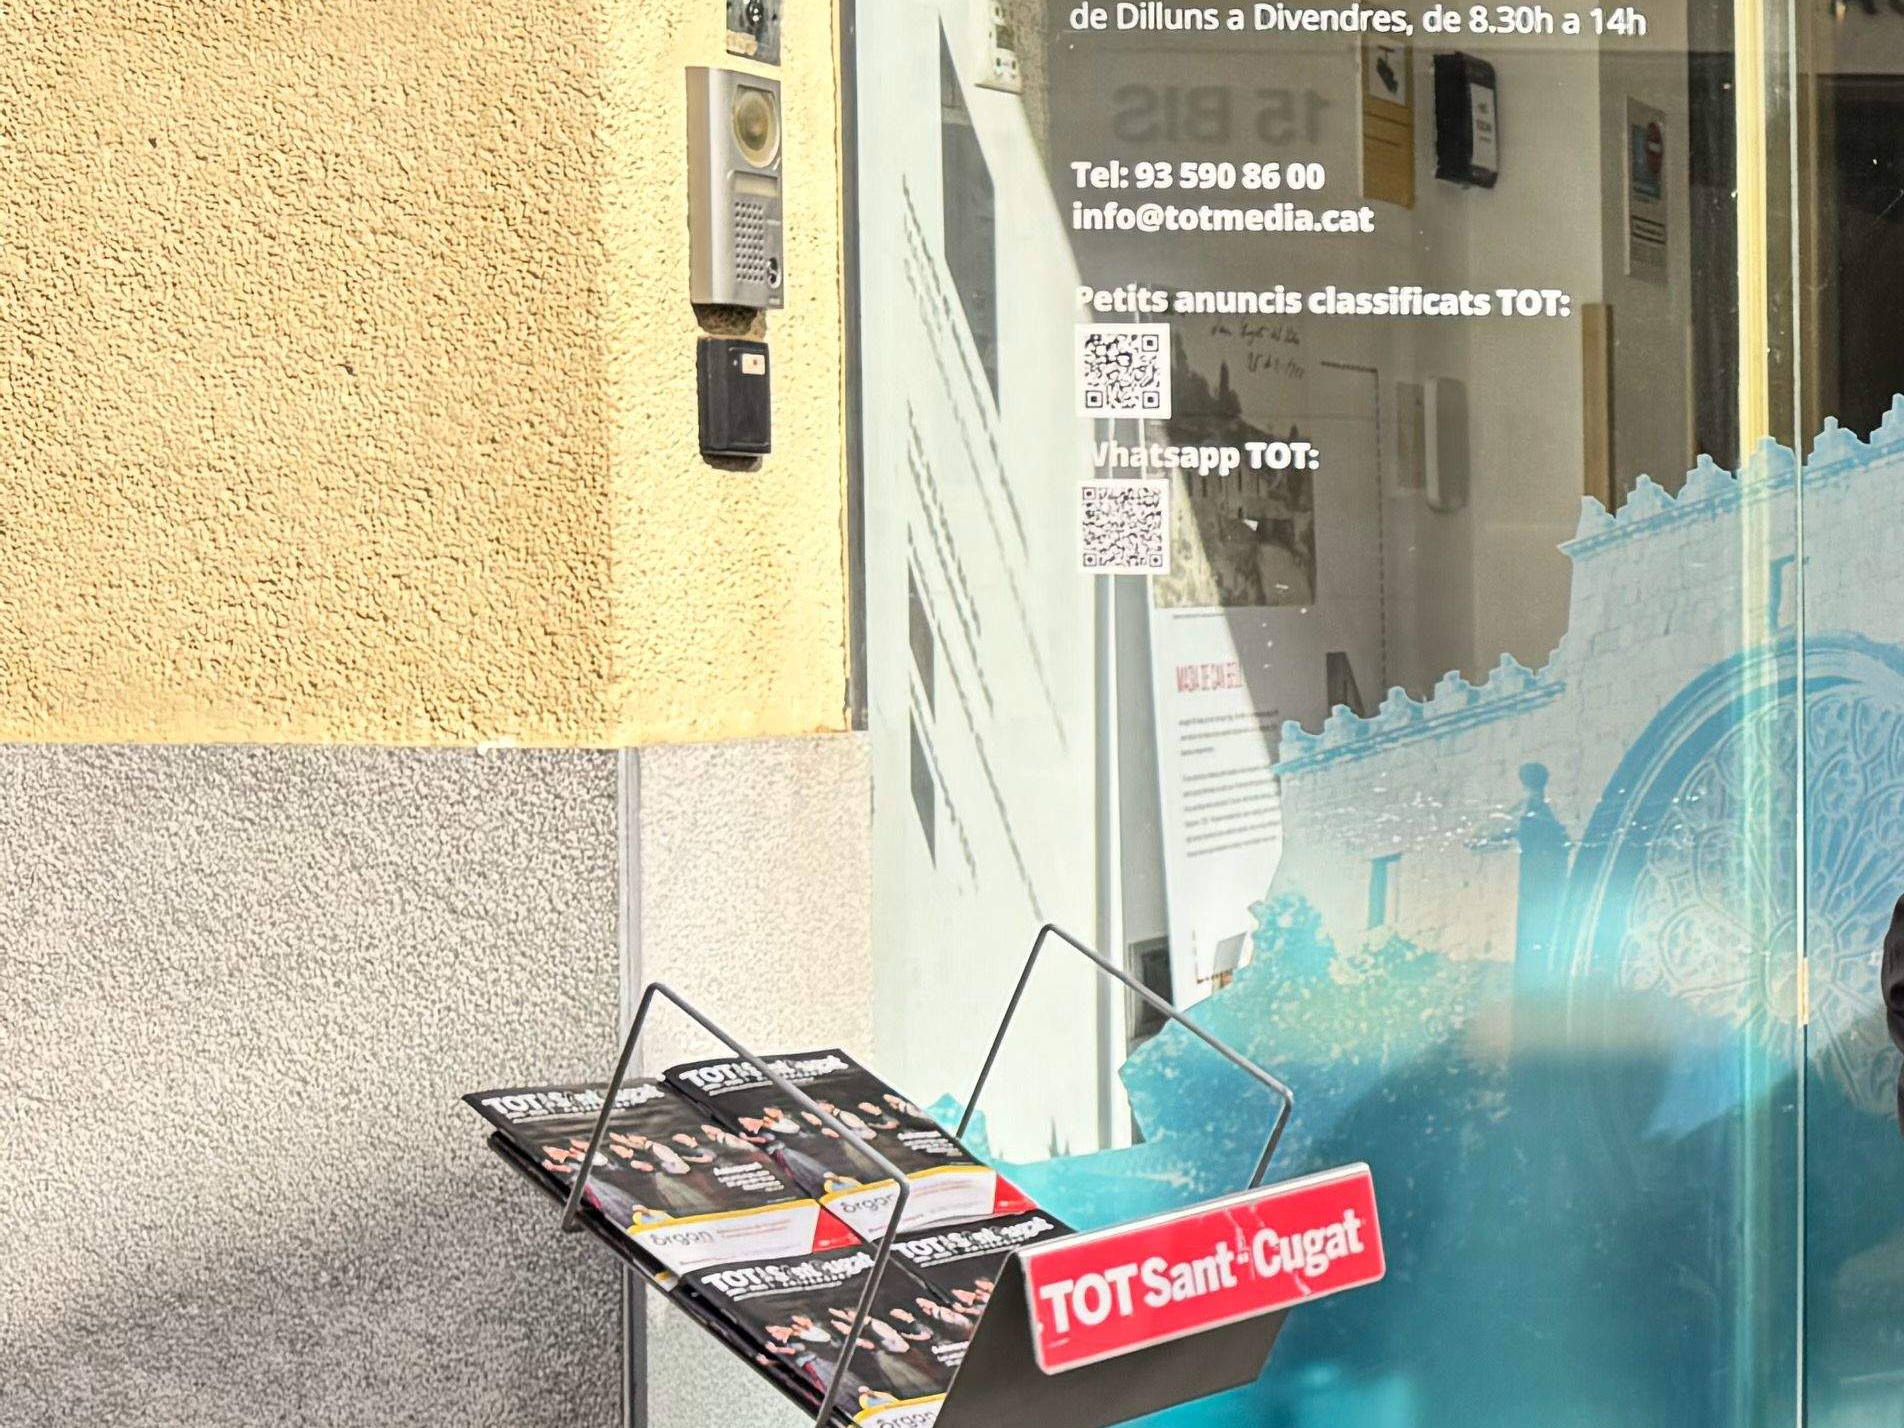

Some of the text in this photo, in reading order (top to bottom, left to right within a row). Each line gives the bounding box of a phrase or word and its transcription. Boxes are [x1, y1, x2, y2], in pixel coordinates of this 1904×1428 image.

[1070, 2, 1646, 37] de Dilluns a Divendres, de 8.30h a 14h
[1071, 160, 1325, 190] Tel: 93 590 86 00
[1072, 202, 1374, 232] info@totmedia.cat
[1173, 284, 1302, 314] anuncis
[1308, 286, 1490, 316] classificats
[1496, 289, 1571, 317] TOT:
[1245, 442, 1320, 470] TOT:
[1040, 1208, 1364, 1333] TOT Sant Cugat
